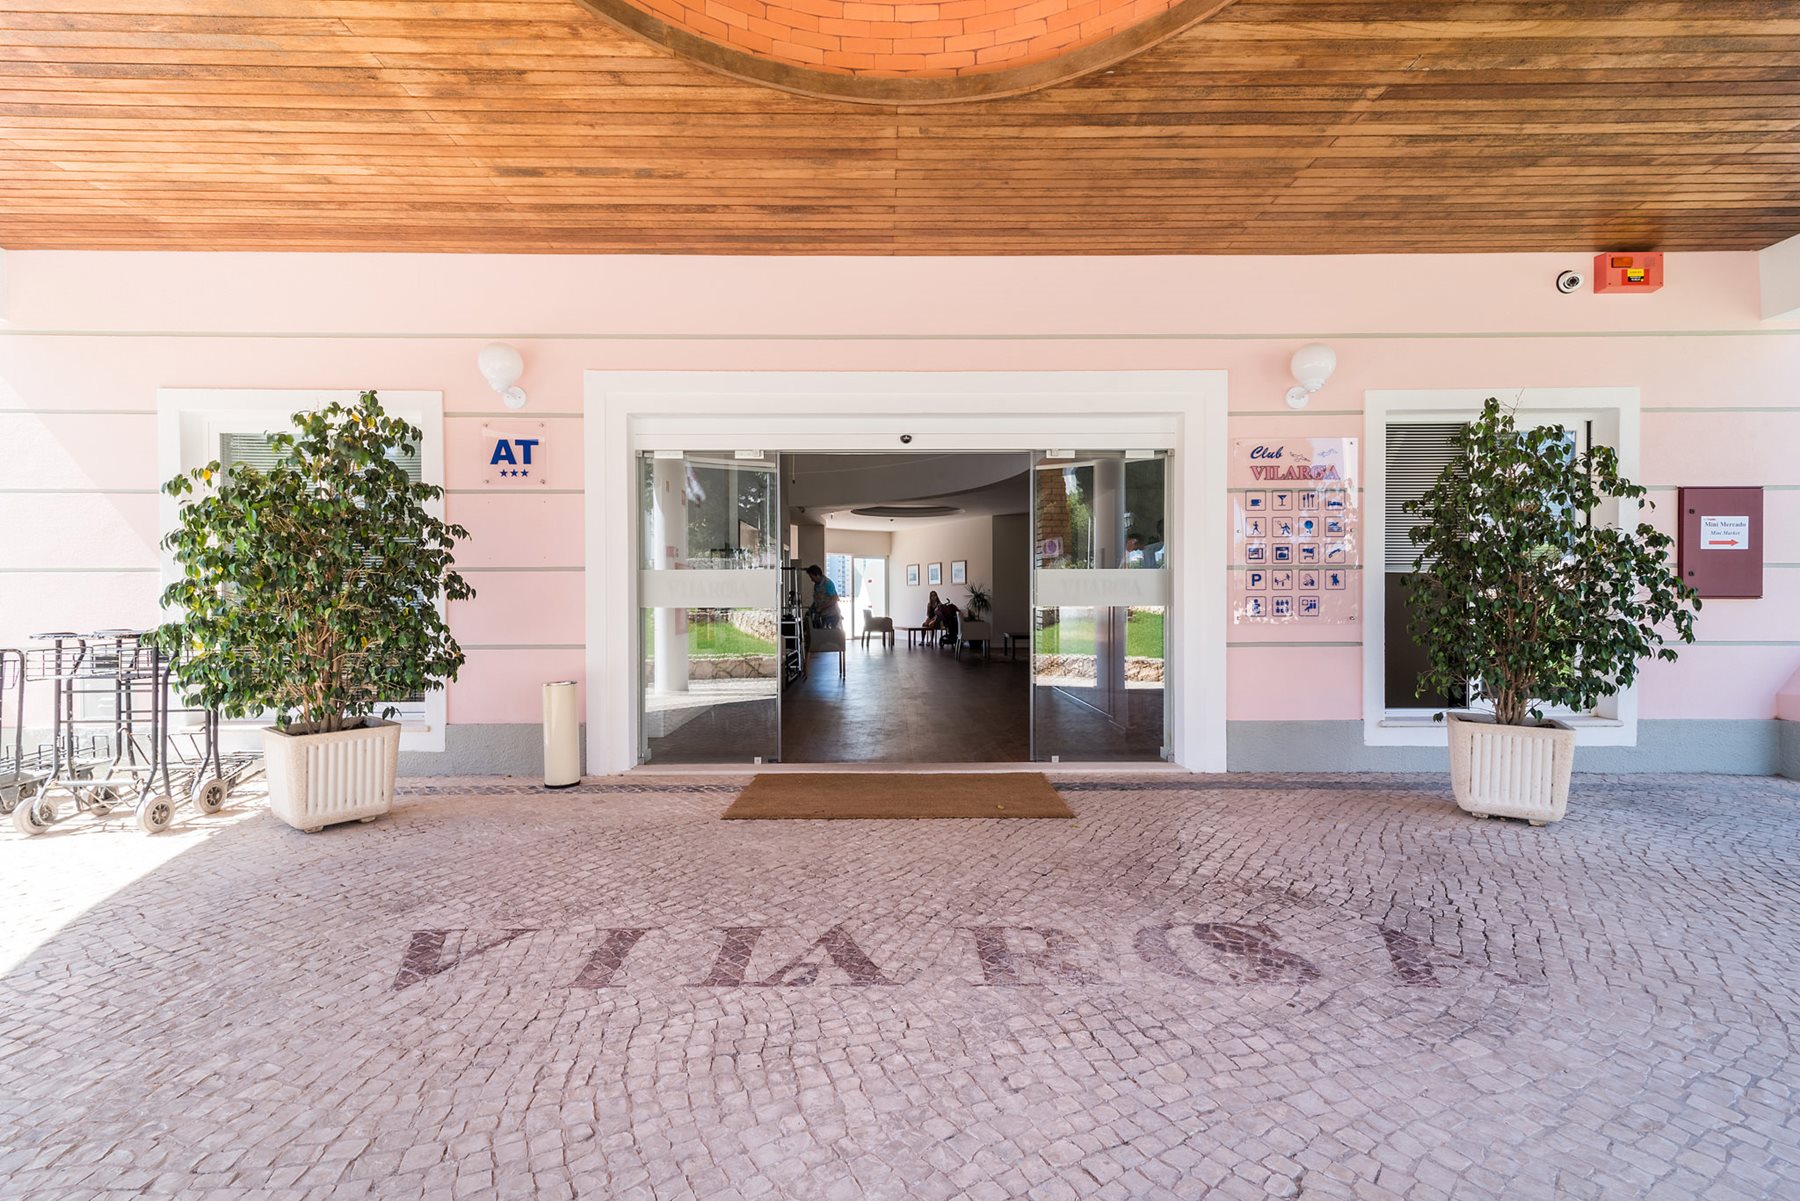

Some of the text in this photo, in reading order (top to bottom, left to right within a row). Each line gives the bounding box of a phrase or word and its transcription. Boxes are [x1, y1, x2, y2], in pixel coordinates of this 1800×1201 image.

[490, 439, 539, 465] AT
[1250, 445, 1284, 460] Club
[1251, 574, 1262, 586] P
